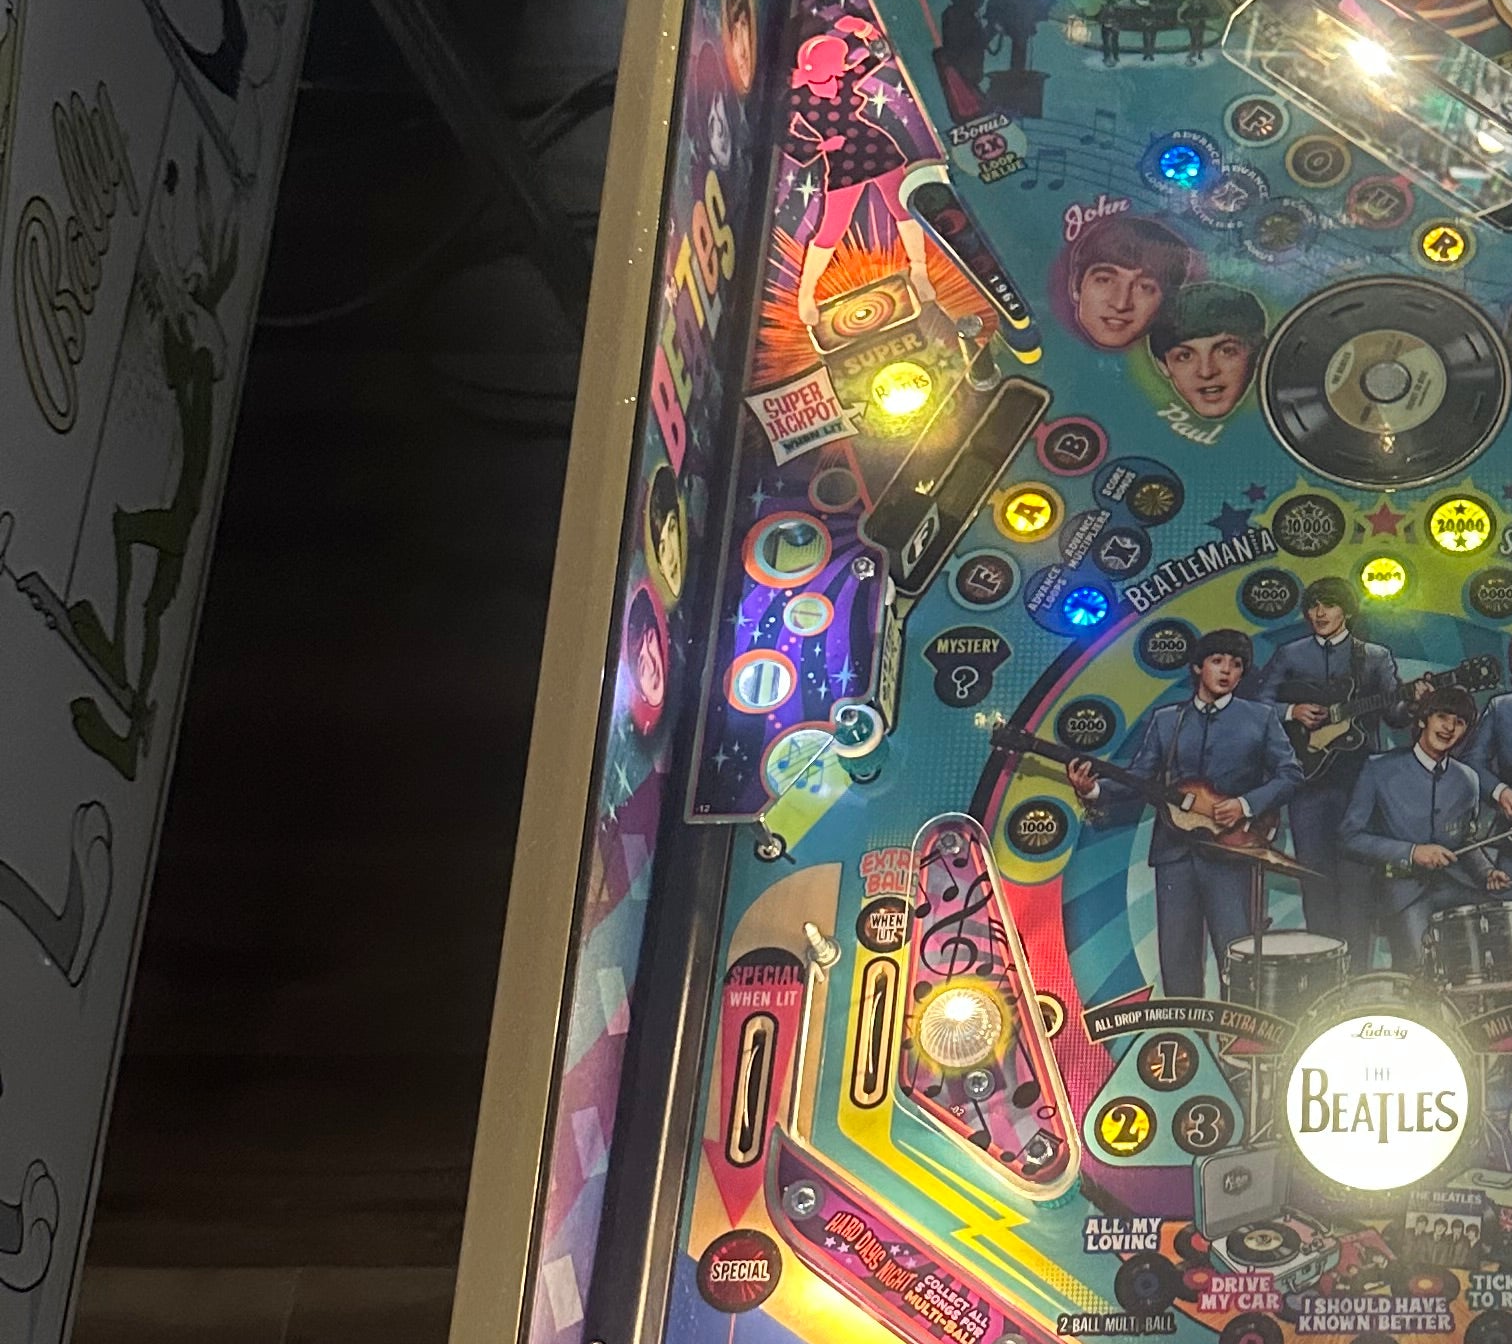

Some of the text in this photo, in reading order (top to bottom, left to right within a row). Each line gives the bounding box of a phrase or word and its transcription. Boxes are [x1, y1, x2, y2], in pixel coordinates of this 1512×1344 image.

[1065, 196, 1129, 241] John
[763, 382, 821, 420] SUPER
[766, 399, 842, 439] JACKPOT
[1158, 404, 1227, 445] Paul
[1124, 528, 1279, 612] BEATLEMANIA
[1252, 587, 1289, 601] 4000
[937, 639, 1000, 654] MYSTERY
[1022, 820, 1055, 834] 1000
[871, 915, 904, 928] WHEN
[730, 990, 798, 1006] WHEN LIT
[1095, 1008, 1257, 1033] ALL DROP TARGETS EXTRA
[1352, 1022, 1408, 1040] Ludwig
[1158, 1041, 1178, 1083] 1
[1299, 1067, 1459, 1143] BEATLES
[1111, 1104, 1143, 1144] 2
[1187, 1104, 1221, 1147] 3
[1086, 1218, 1161, 1235] ALL MY
[827, 1213, 887, 1270] HARD DAYS
[1087, 1234, 1158, 1251] LOVING
[712, 1260, 770, 1281] SPECIAL
[1211, 1277, 1270, 1292] DRIVE
[924, 1275, 990, 1328] COLLECT ALL
[1201, 1293, 1280, 1310] MY CAR
[1312, 1297, 1446, 1314] SHOULD HAVE
[1470, 1292, 1495, 1307] TO
[925, 1288, 985, 1339] SONGS FOR
[1299, 1313, 1452, 1332] KNOWN BETTER
